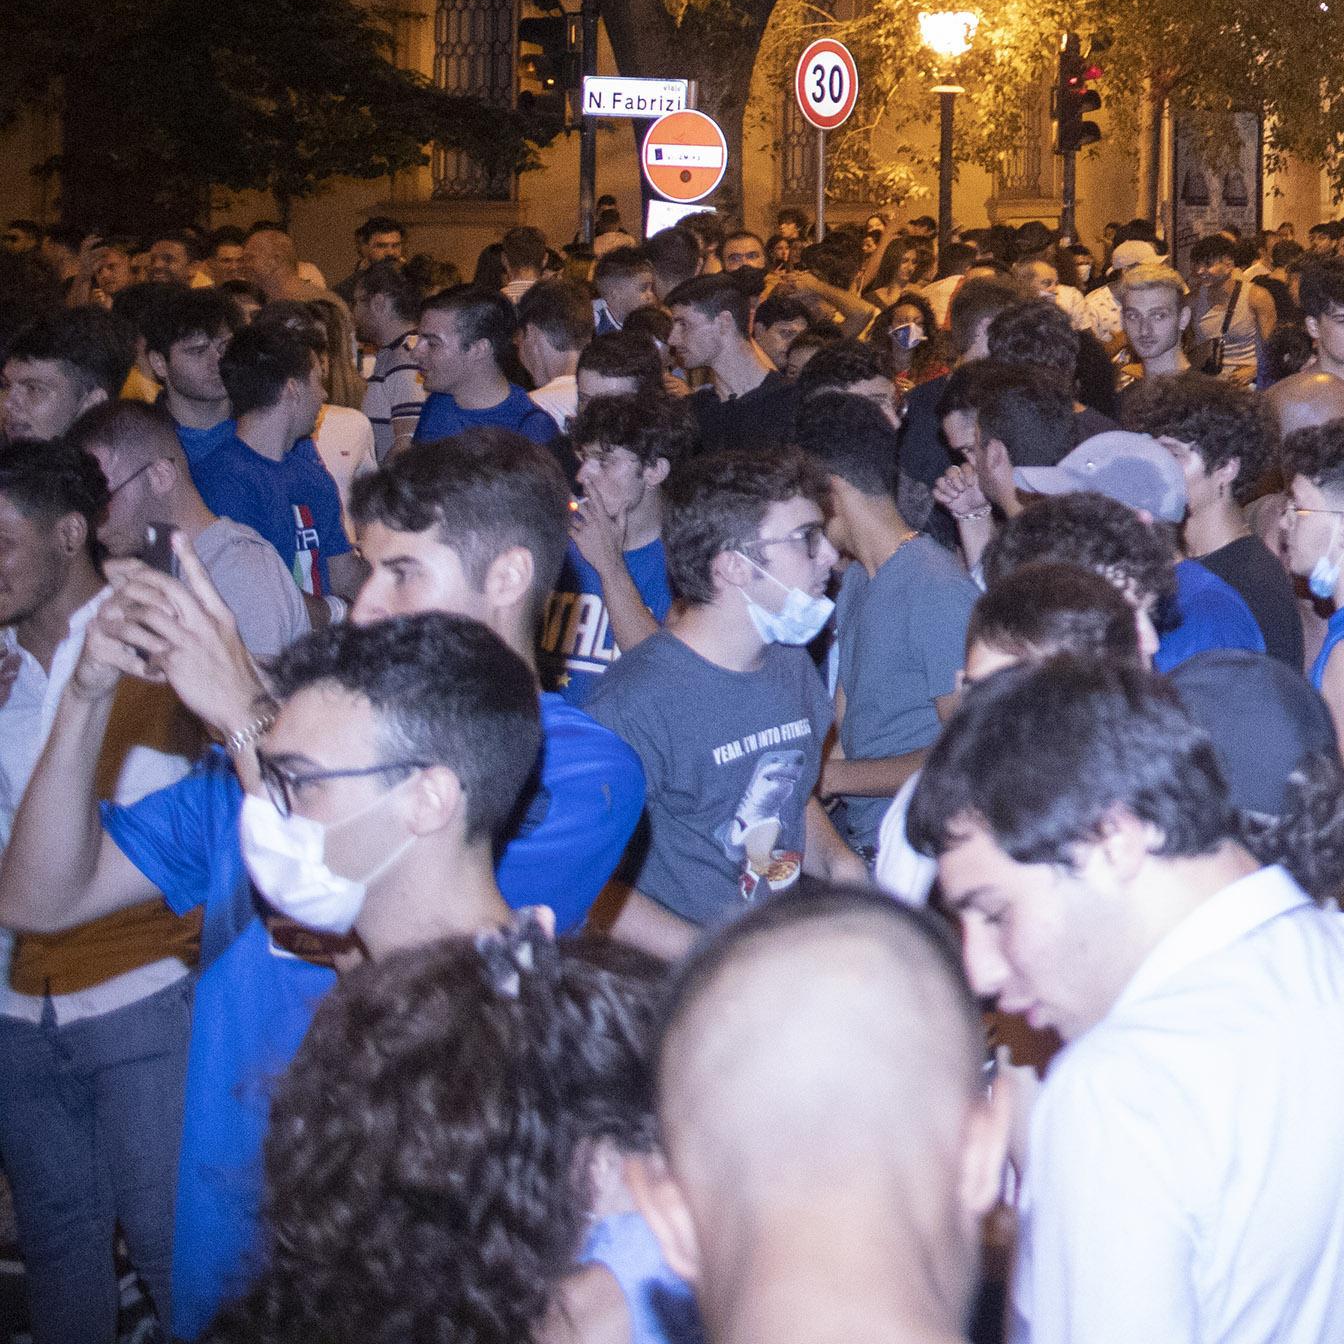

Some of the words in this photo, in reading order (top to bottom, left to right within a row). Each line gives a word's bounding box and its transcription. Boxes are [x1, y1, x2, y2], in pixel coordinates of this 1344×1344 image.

[588, 91, 606, 109] N.
[612, 92, 682, 112] Fabrizi
[811, 63, 844, 104] 30
[541, 591, 622, 662] ITAL
[743, 734, 758, 753] I'M
[758, 726, 780, 748] INTO
[781, 718, 812, 741] FITNESS
